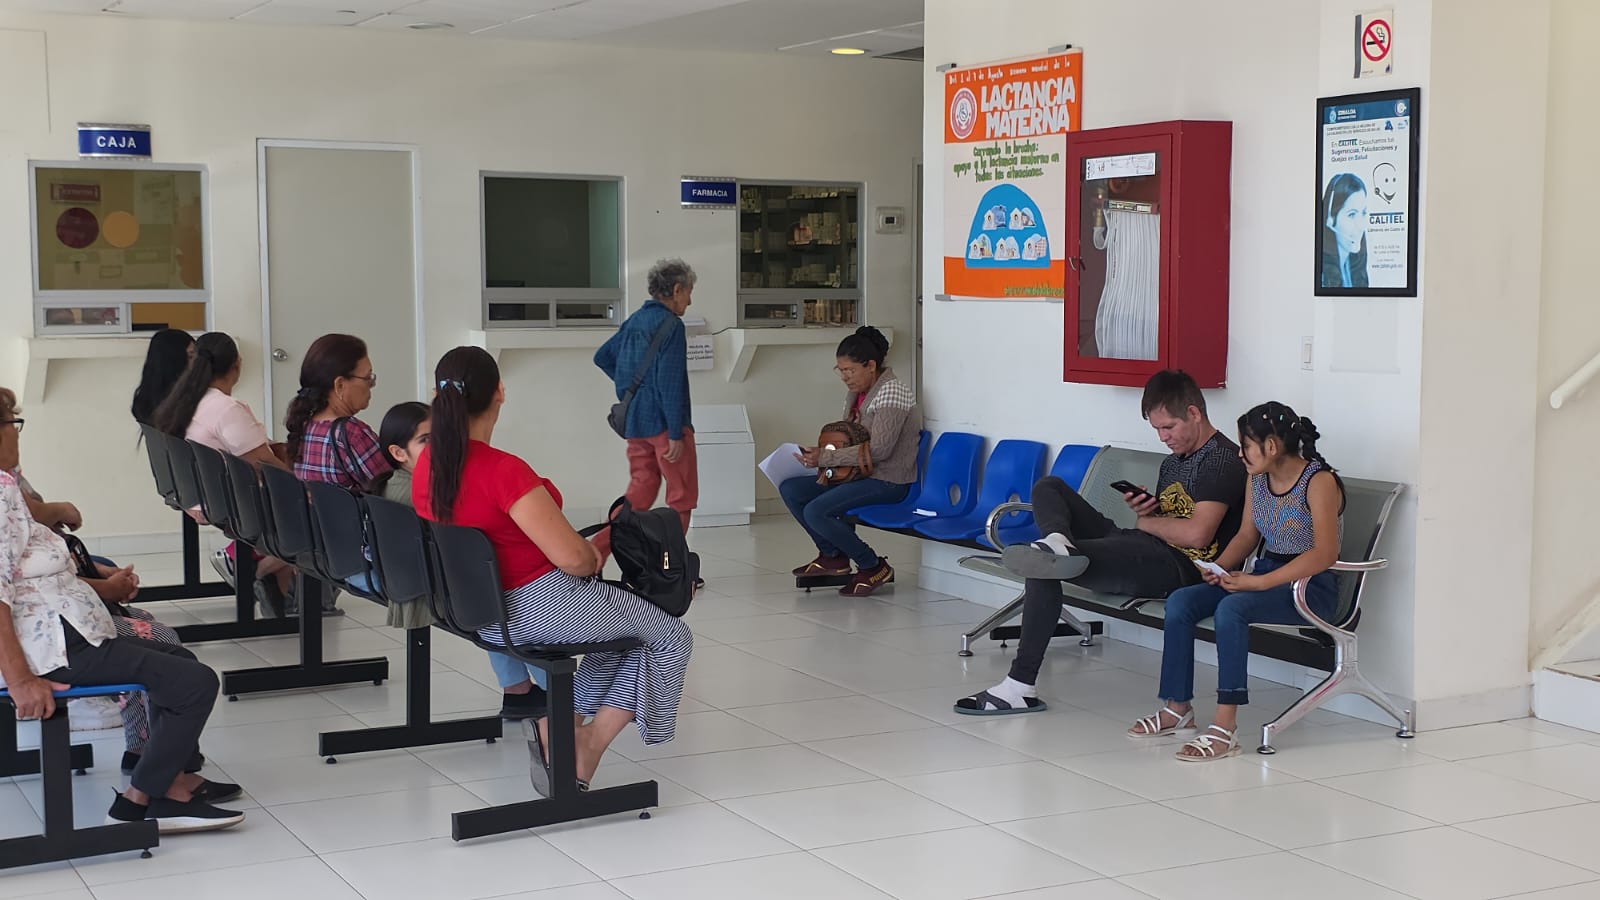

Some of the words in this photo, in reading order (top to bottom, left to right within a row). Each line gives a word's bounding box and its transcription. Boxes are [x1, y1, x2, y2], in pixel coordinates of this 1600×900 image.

[981, 76, 1075, 112] LACTANCIA
[985, 105, 1070, 139] MATERNA
[97, 136, 137, 148] CAJA
[692, 189, 728, 197] FARMACIA
[1369, 212, 1404, 224] CALITEL
